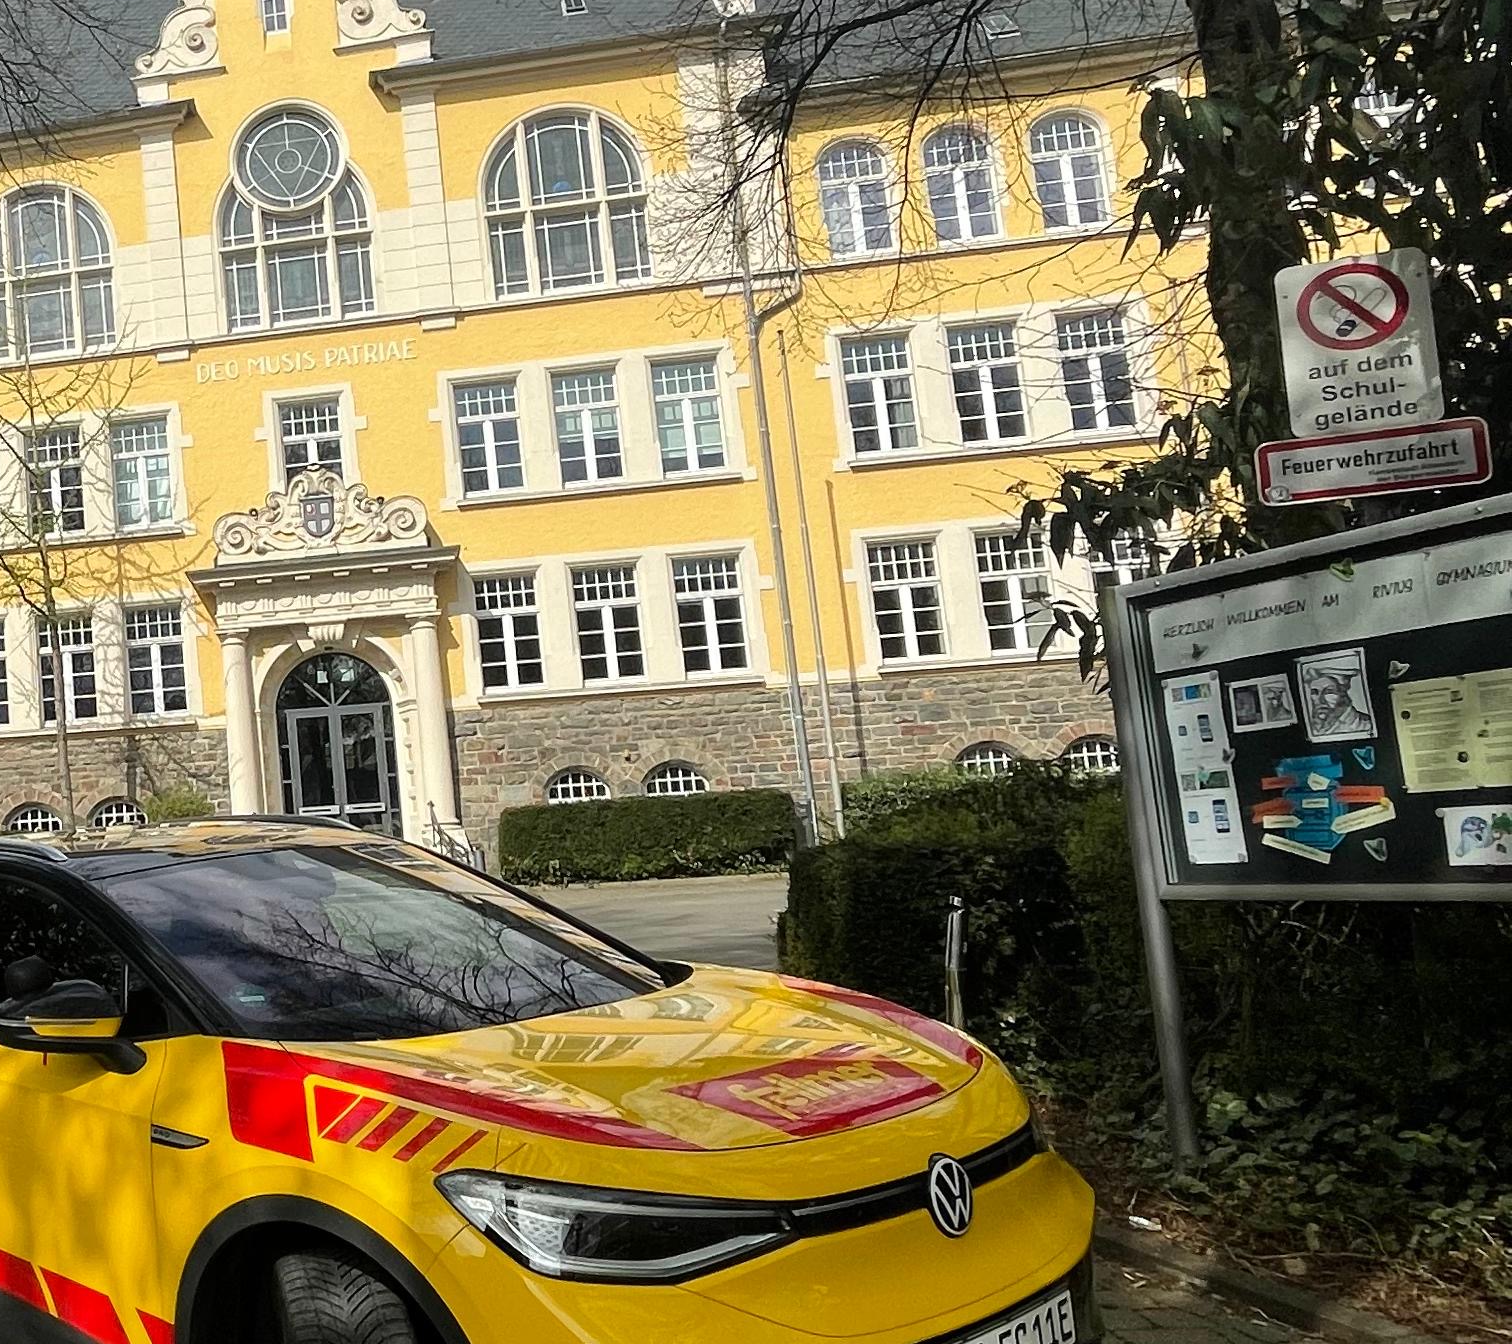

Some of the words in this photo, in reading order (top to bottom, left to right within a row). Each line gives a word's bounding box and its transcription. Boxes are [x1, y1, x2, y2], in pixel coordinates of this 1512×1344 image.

[196, 360, 239, 384] DEO
[247, 350, 316, 377] MUSIS
[324, 338, 417, 368] PATRIAE
[1308, 358, 1349, 380] auf
[1357, 354, 1412, 373] dem
[1321, 377, 1406, 401] Schul-
[1315, 400, 1418, 431] gelände
[1281, 439, 1459, 475] Feuerwehrzufahrt
[1227, 599, 1306, 626] WILLKOMMEN
[1321, 594, 1339, 607] AM
[727, 1061, 885, 1121] fellmer
